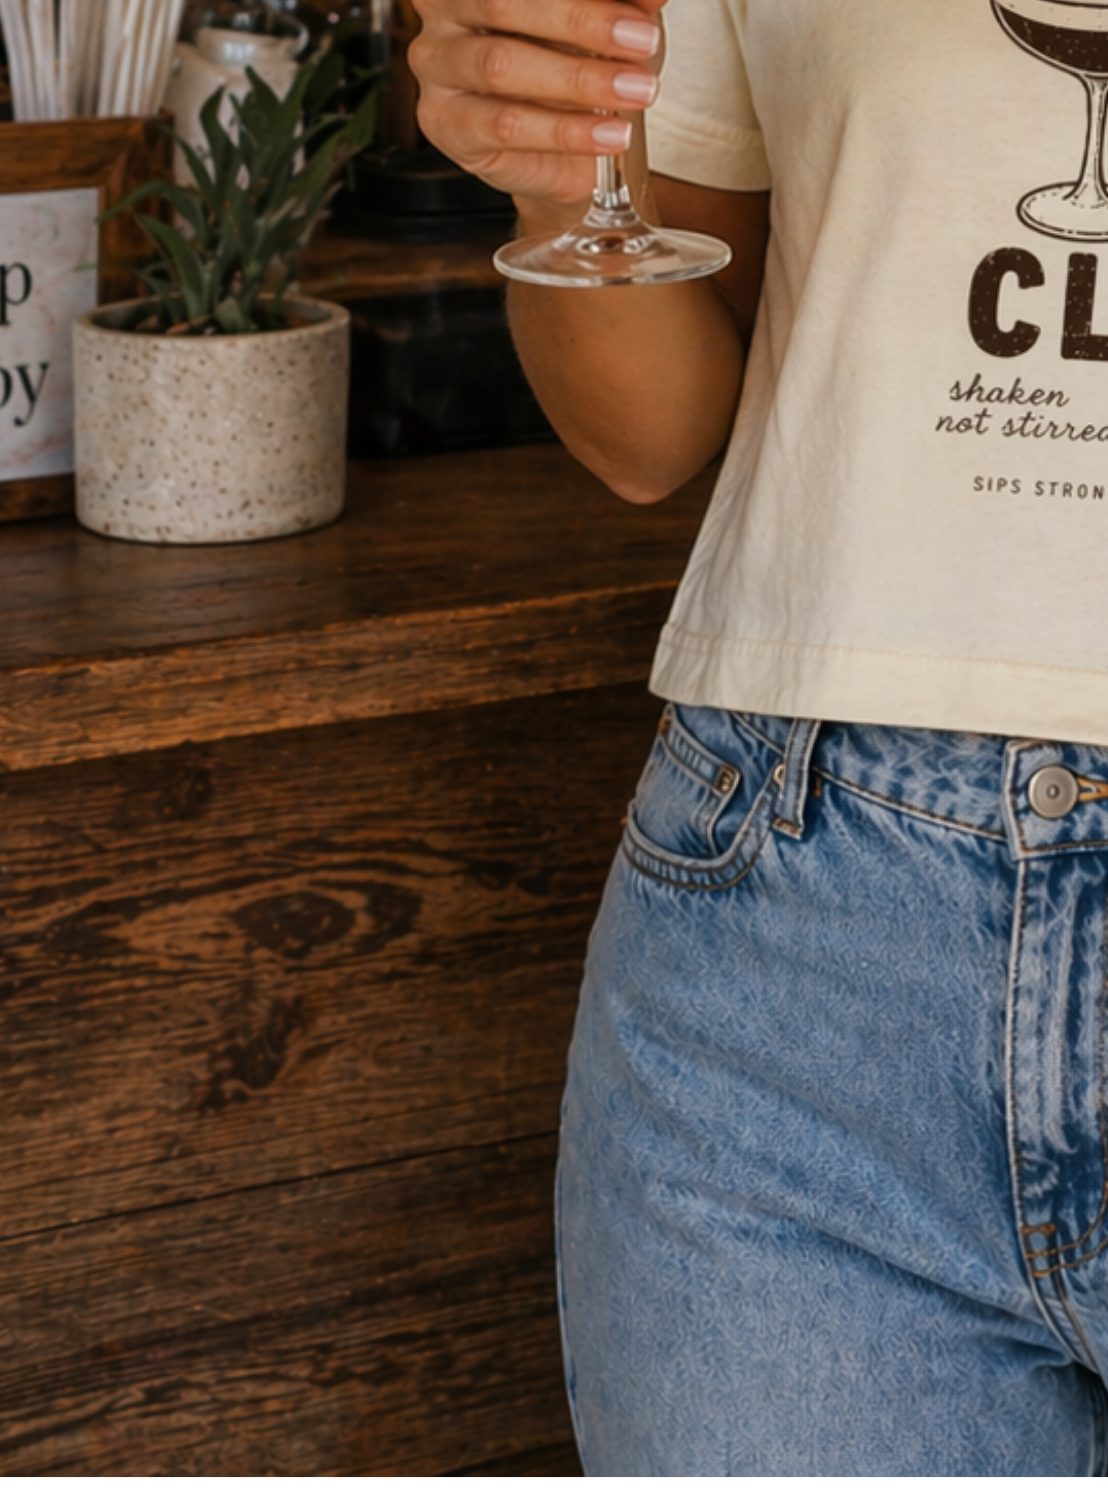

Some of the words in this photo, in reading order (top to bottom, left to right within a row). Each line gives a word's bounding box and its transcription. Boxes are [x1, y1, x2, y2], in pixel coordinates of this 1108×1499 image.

[949, 373, 1069, 408] shaken
[935, 408, 991, 435] not
[972, 475, 1022, 496] SIPS
